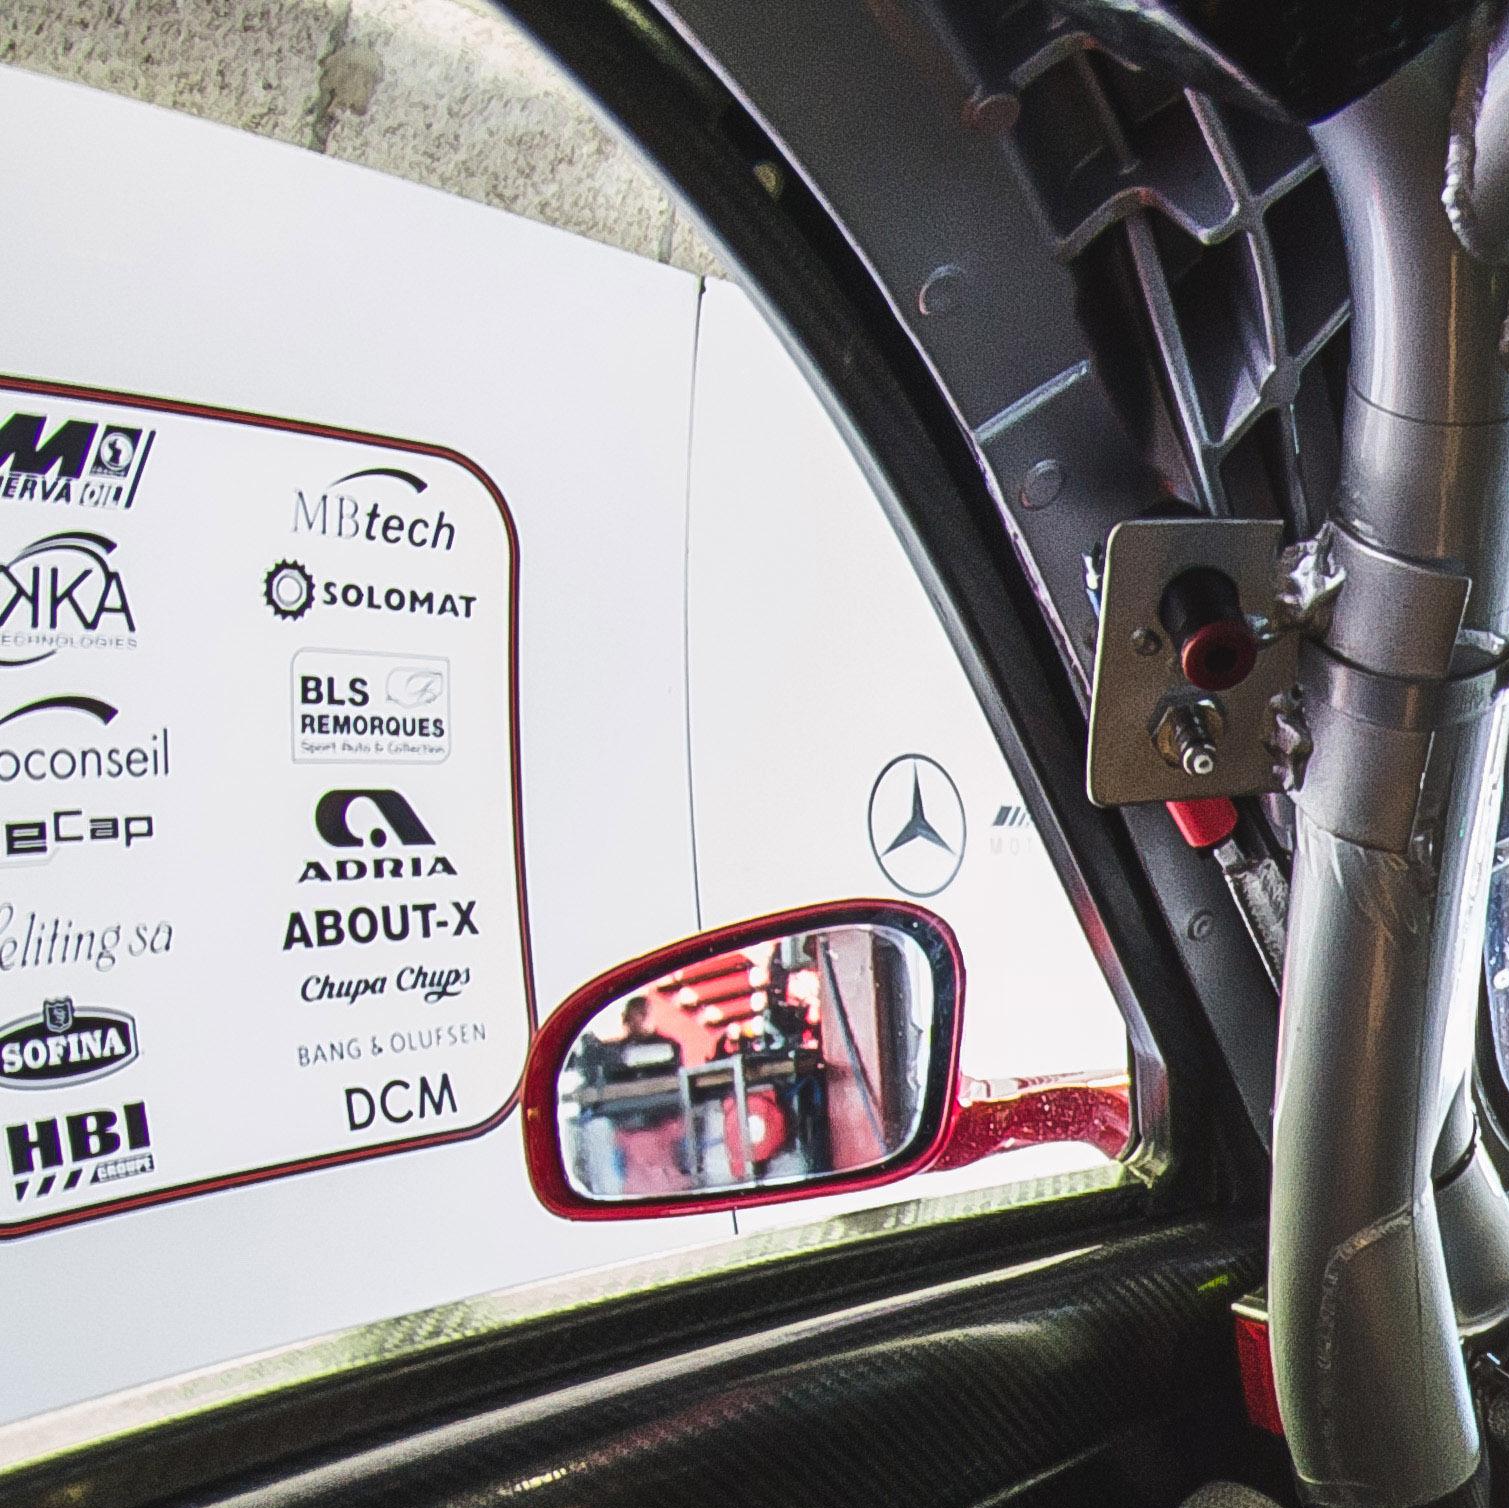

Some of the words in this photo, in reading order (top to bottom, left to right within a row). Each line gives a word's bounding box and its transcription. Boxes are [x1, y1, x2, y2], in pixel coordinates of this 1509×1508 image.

[0, 476, 71, 504] ERVA
[292, 490, 456, 550] MBtech
[323, 582, 477, 618] SOLOMAT
[301, 676, 369, 706] BLS
[301, 714, 445, 737] REMORQUES
[298, 857, 457, 883] ADRIA
[129, 921, 172, 956] sa
[283, 901, 479, 950] ABOUT-X
[300, 974, 387, 1004] Chupa
[396, 966, 471, 1003] Chups
[2, 1027, 125, 1074] SOFINA
[299, 1037, 362, 1066] BANG
[390, 1024, 486, 1054] OLUFSEN
[345, 1073, 457, 1131] DCM
[6, 1100, 150, 1175] HBI
